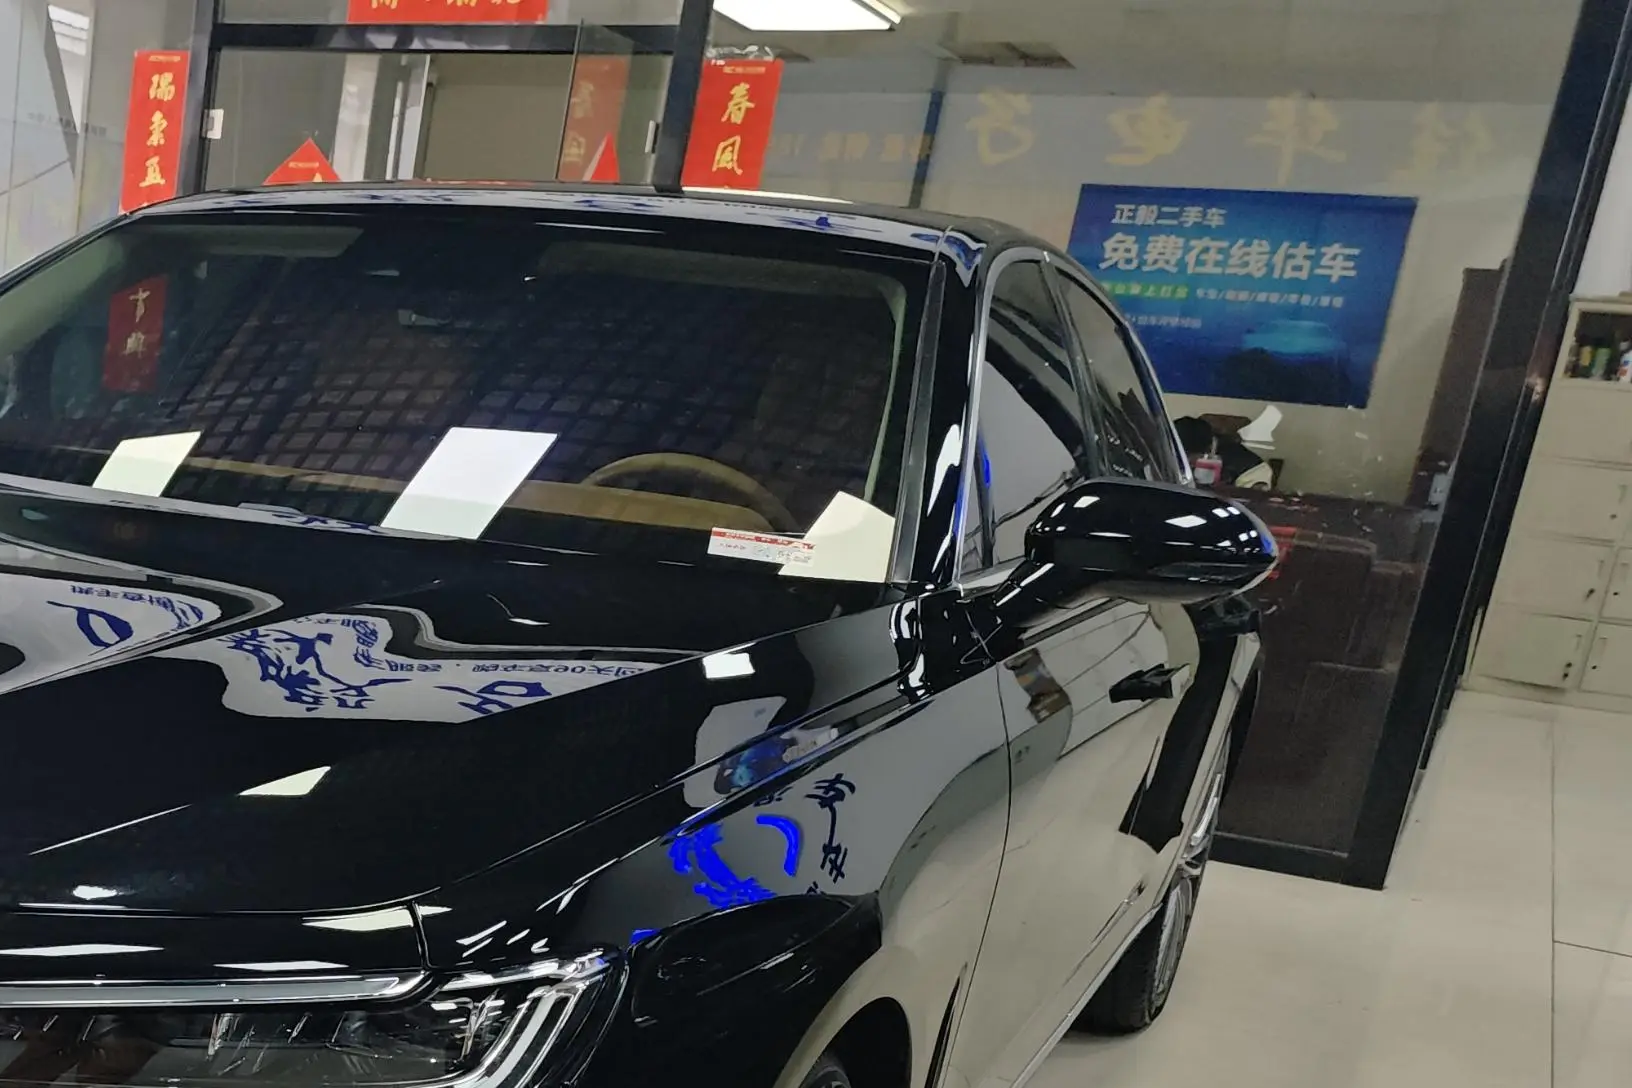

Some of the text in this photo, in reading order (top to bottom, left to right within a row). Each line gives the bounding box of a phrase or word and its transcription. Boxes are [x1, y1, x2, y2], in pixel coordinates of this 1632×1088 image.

[1099, 232, 1361, 283] 免费在线估车
